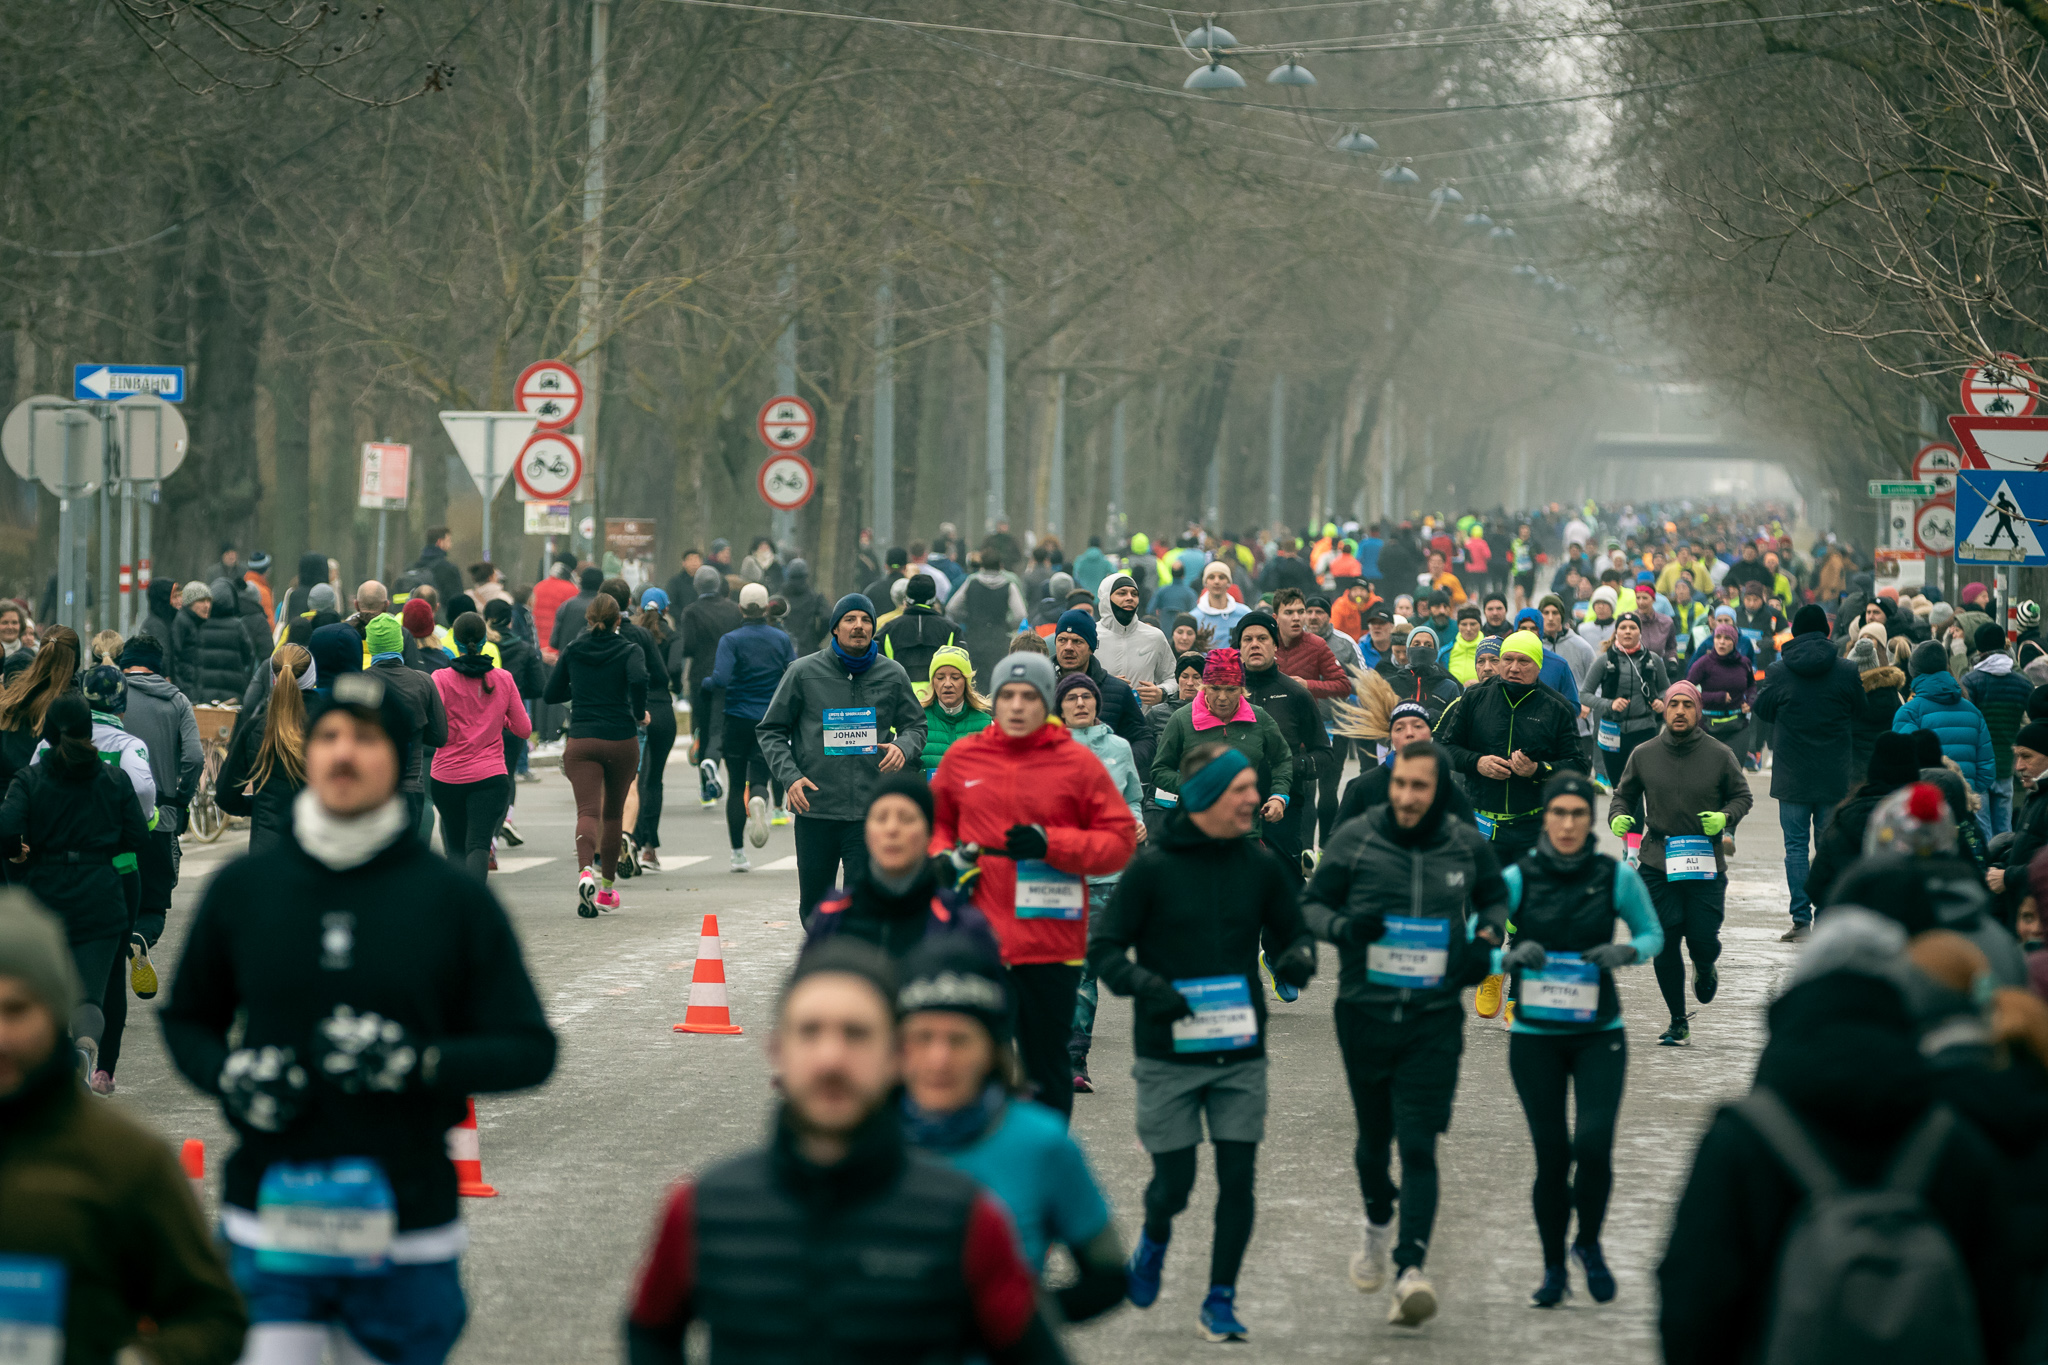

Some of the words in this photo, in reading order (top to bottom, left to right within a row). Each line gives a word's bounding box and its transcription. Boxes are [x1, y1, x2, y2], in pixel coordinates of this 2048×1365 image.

[109, 376, 170, 390] EINBAHN
[833, 730, 868, 739] JOHANN
[1029, 885, 1072, 896] MICHAEL
[1390, 951, 1428, 964] PETER
[1542, 985, 1579, 997] PETRA
